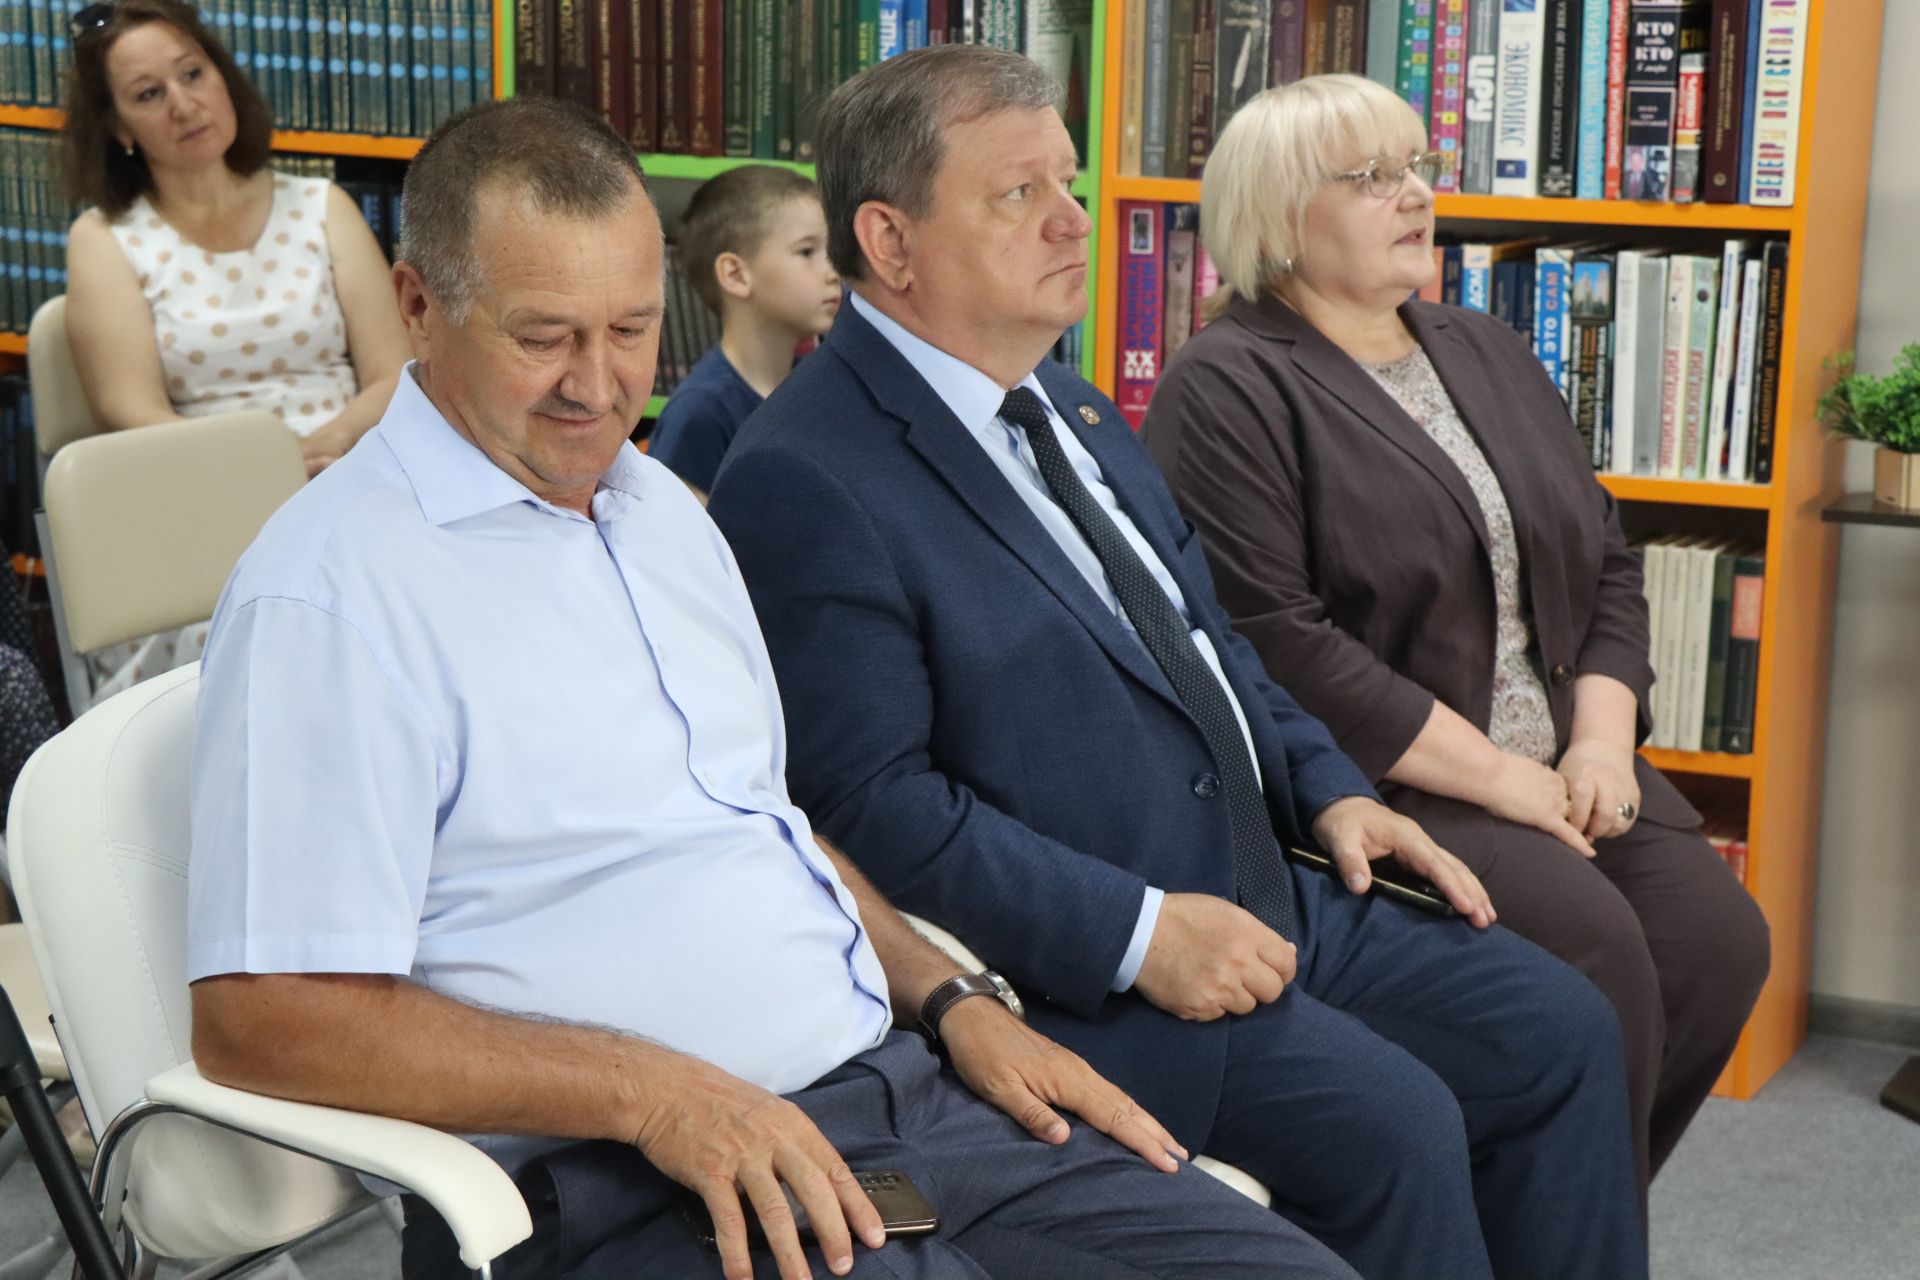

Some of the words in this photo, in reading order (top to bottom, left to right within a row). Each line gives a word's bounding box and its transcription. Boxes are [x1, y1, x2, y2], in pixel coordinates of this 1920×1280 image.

[1635, 46, 1674, 61] КТО
[1636, 21, 1675, 37] КТО
[1466, 55, 1496, 122] ЦРУ
[1501, 42, 1531, 148] ЭКОНОМИКС
[1761, 27, 1794, 119] ИСКУССТВА
[1755, 129, 1787, 198] ШЕДЕВРЫ
[1140, 262, 1157, 349] РОССИИ
[1467, 268, 1486, 309] ДОМ
[1544, 271, 1558, 311] САМ
[1544, 317, 1557, 353] ЭТО
